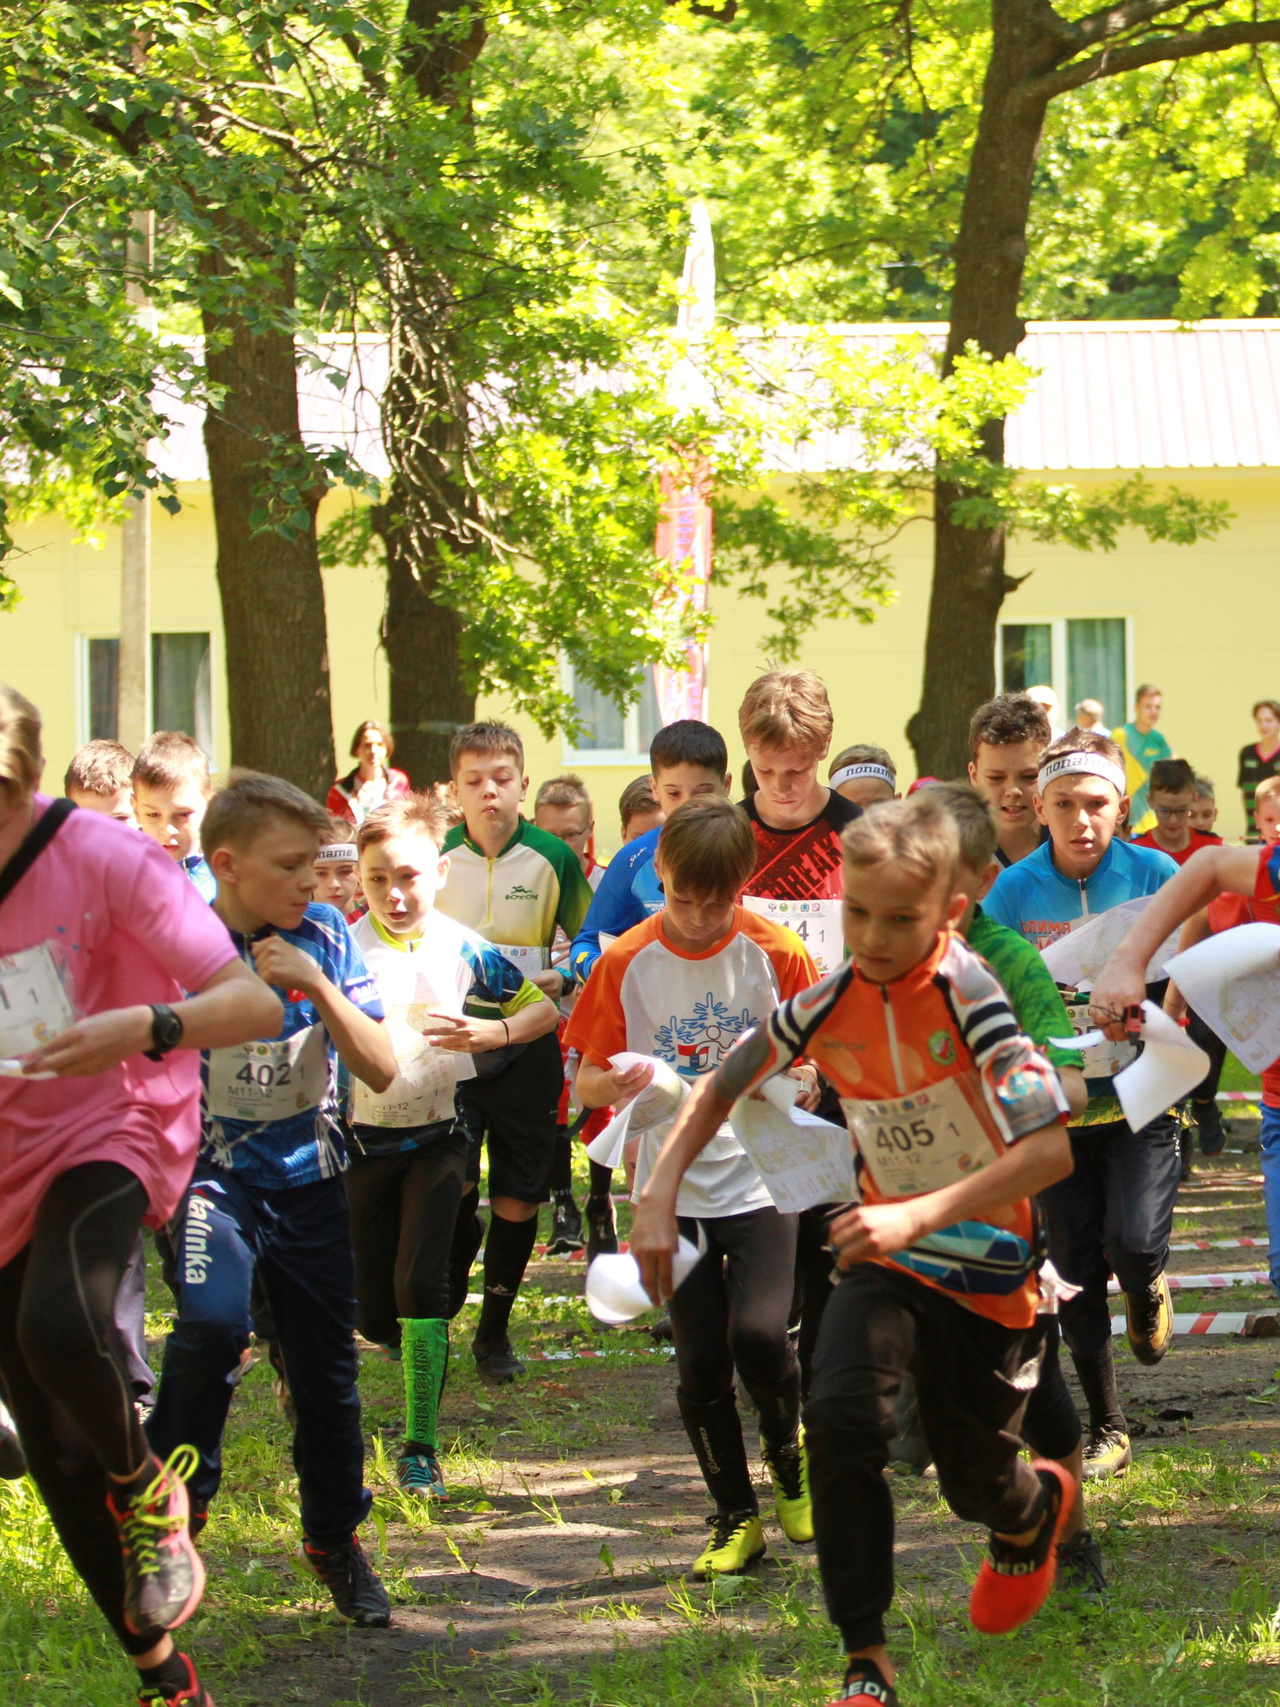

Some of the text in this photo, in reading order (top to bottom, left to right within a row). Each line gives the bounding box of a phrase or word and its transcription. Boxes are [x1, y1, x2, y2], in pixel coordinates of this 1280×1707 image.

[236, 1062, 291, 1086] 402
[228, 1085, 273, 1098] M11-12
[876, 1119, 960, 1152] 405 1
[877, 1152, 921, 1166] M11-12
[414, 1338, 429, 1441] ORIENTEERING
